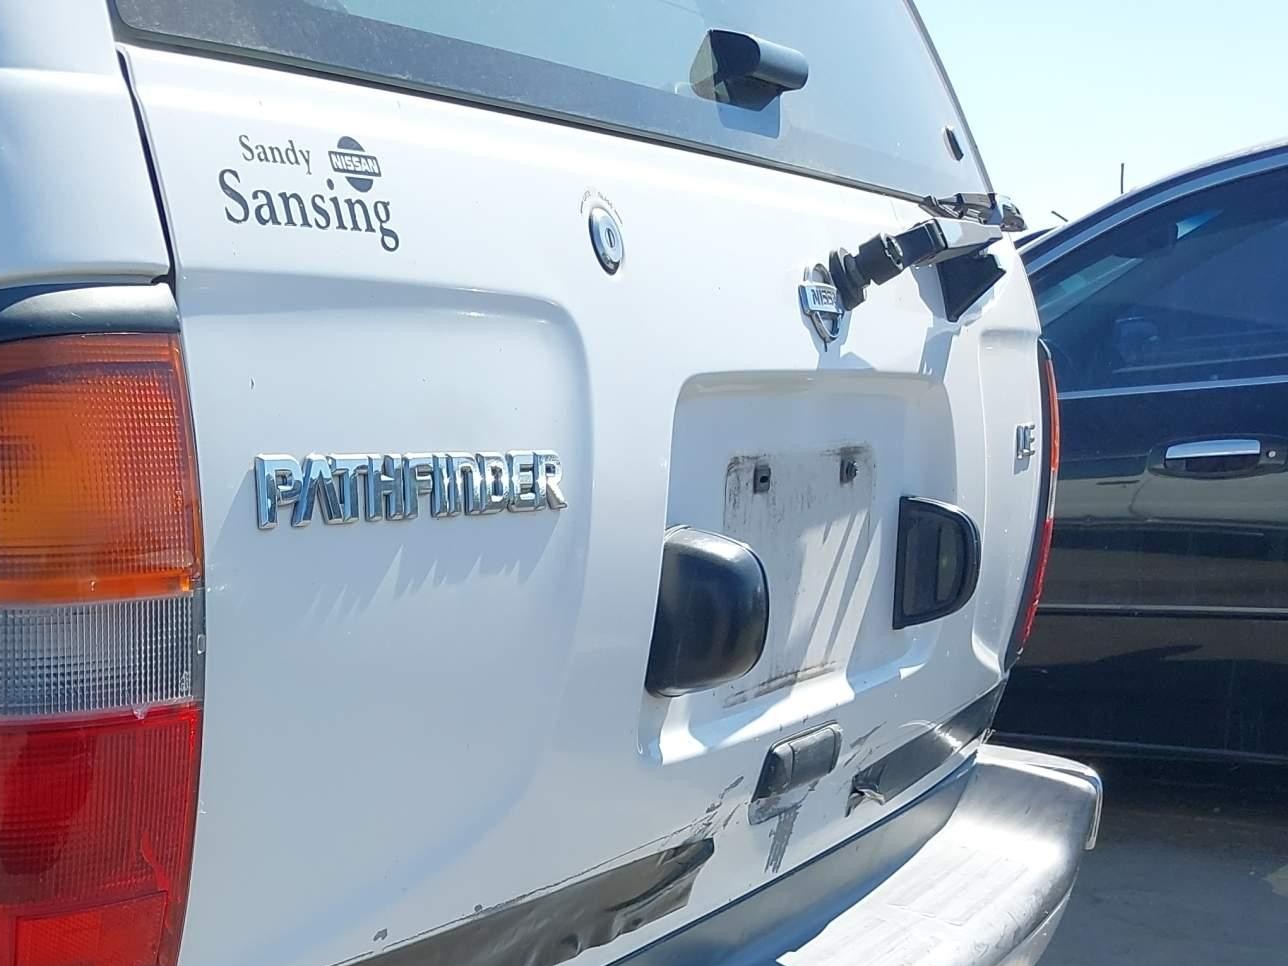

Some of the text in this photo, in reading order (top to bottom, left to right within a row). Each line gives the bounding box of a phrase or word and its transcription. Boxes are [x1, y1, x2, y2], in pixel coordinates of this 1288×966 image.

[238, 134, 312, 175] Sandy
[329, 153, 379, 175] NISSAN
[218, 168, 400, 252] Sansing
[1015, 424, 1036, 459] LE
[255, 450, 568, 529] PATHFINDER
